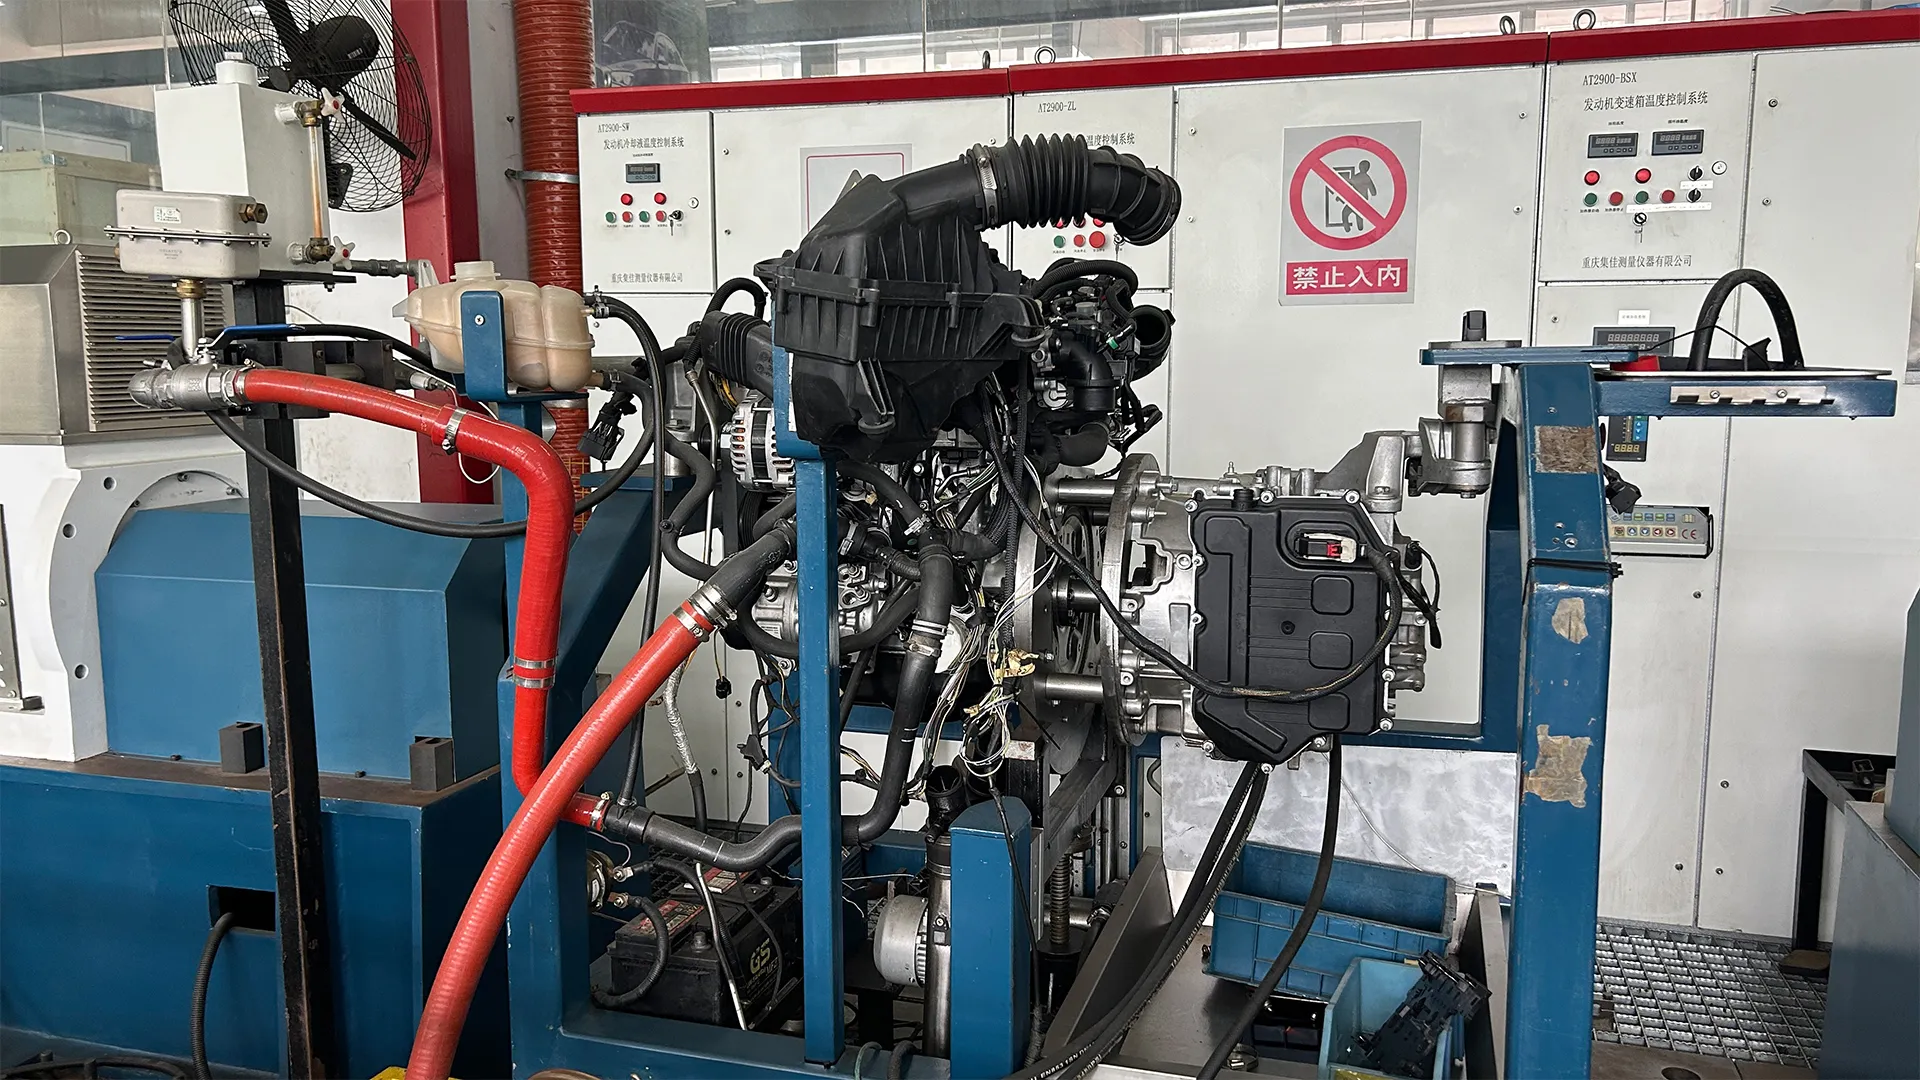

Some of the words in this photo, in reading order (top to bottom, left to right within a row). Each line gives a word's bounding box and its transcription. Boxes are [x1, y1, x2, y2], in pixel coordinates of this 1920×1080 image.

[1583, 72, 1638, 86] AT2900-BSX
[1038, 100, 1077, 113] AT2900-ZL
[1584, 91, 1708, 111] 发动机变速箱温度控制系统
[597, 122, 630, 134] AT2900-SW
[1582, 254, 1692, 269] 重庆集佳测量仪器有限公司
[1292, 263, 1401, 290] 禁止入内
[750, 937, 770, 974] GS
